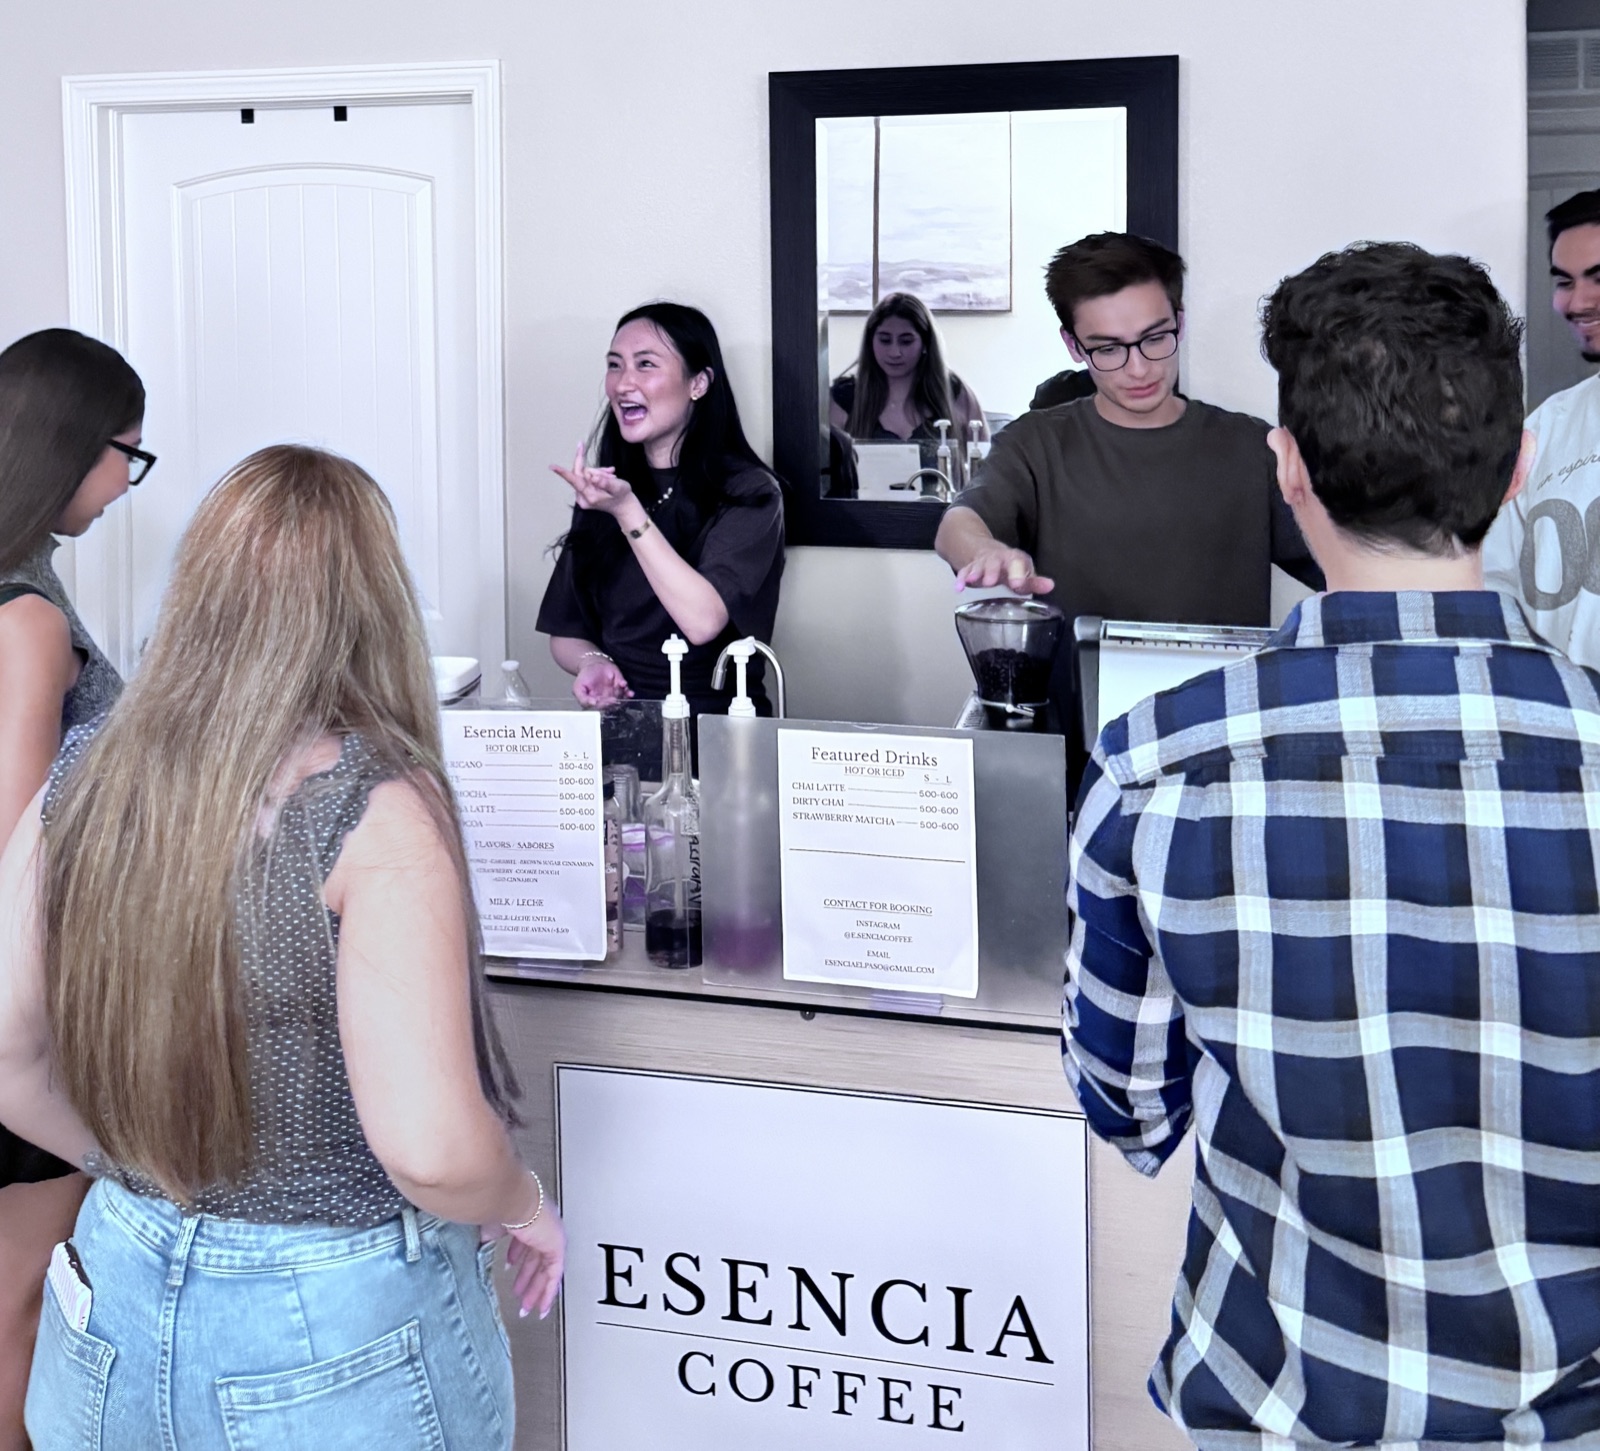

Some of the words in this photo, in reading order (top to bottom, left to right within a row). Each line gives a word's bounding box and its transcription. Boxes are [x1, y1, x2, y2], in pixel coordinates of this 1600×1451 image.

[463, 725, 516, 739] Esencia
[521, 725, 562, 739] Menu
[485, 744, 505, 752] HOT
[506, 744, 518, 752] OR
[519, 745, 540, 753] ICED
[563, 751, 569, 759] S
[811, 747, 880, 764] Featured
[886, 750, 938, 767] Drinks
[844, 766, 865, 776] HOT
[865, 767, 881, 776] OR
[882, 768, 905, 777] ICED
[924, 774, 930, 782] S
[946, 775, 952, 784] L
[792, 782, 815, 790] CHAI
[816, 783, 846, 792] LATTE
[792, 797, 820, 806] DIRTY
[821, 798, 844, 807] CHAI
[469, 805, 496, 813] LATTE
[792, 812, 854, 823] STRAWBERRY
[855, 815, 895, 826] MATCHA
[474, 840, 511, 849] FLAVORS
[517, 841, 555, 849] SABORES
[489, 898, 511, 906] MILK
[516, 898, 544, 907] LECHE
[823, 898, 868, 909] CONTACT
[869, 901, 888, 910] FOR
[889, 903, 933, 914] BOOKING
[856, 919, 901, 930] INSTAGRAM
[844, 931, 913, 943] @ESENCIACOFFEE
[866, 950, 891, 959] EMAIL
[824, 959, 935, 974] ESENCIAELPASO@GMAIL.COM
[596, 1242, 1055, 1365] ESENCIA
[677, 1350, 965, 1433] COFFEE
